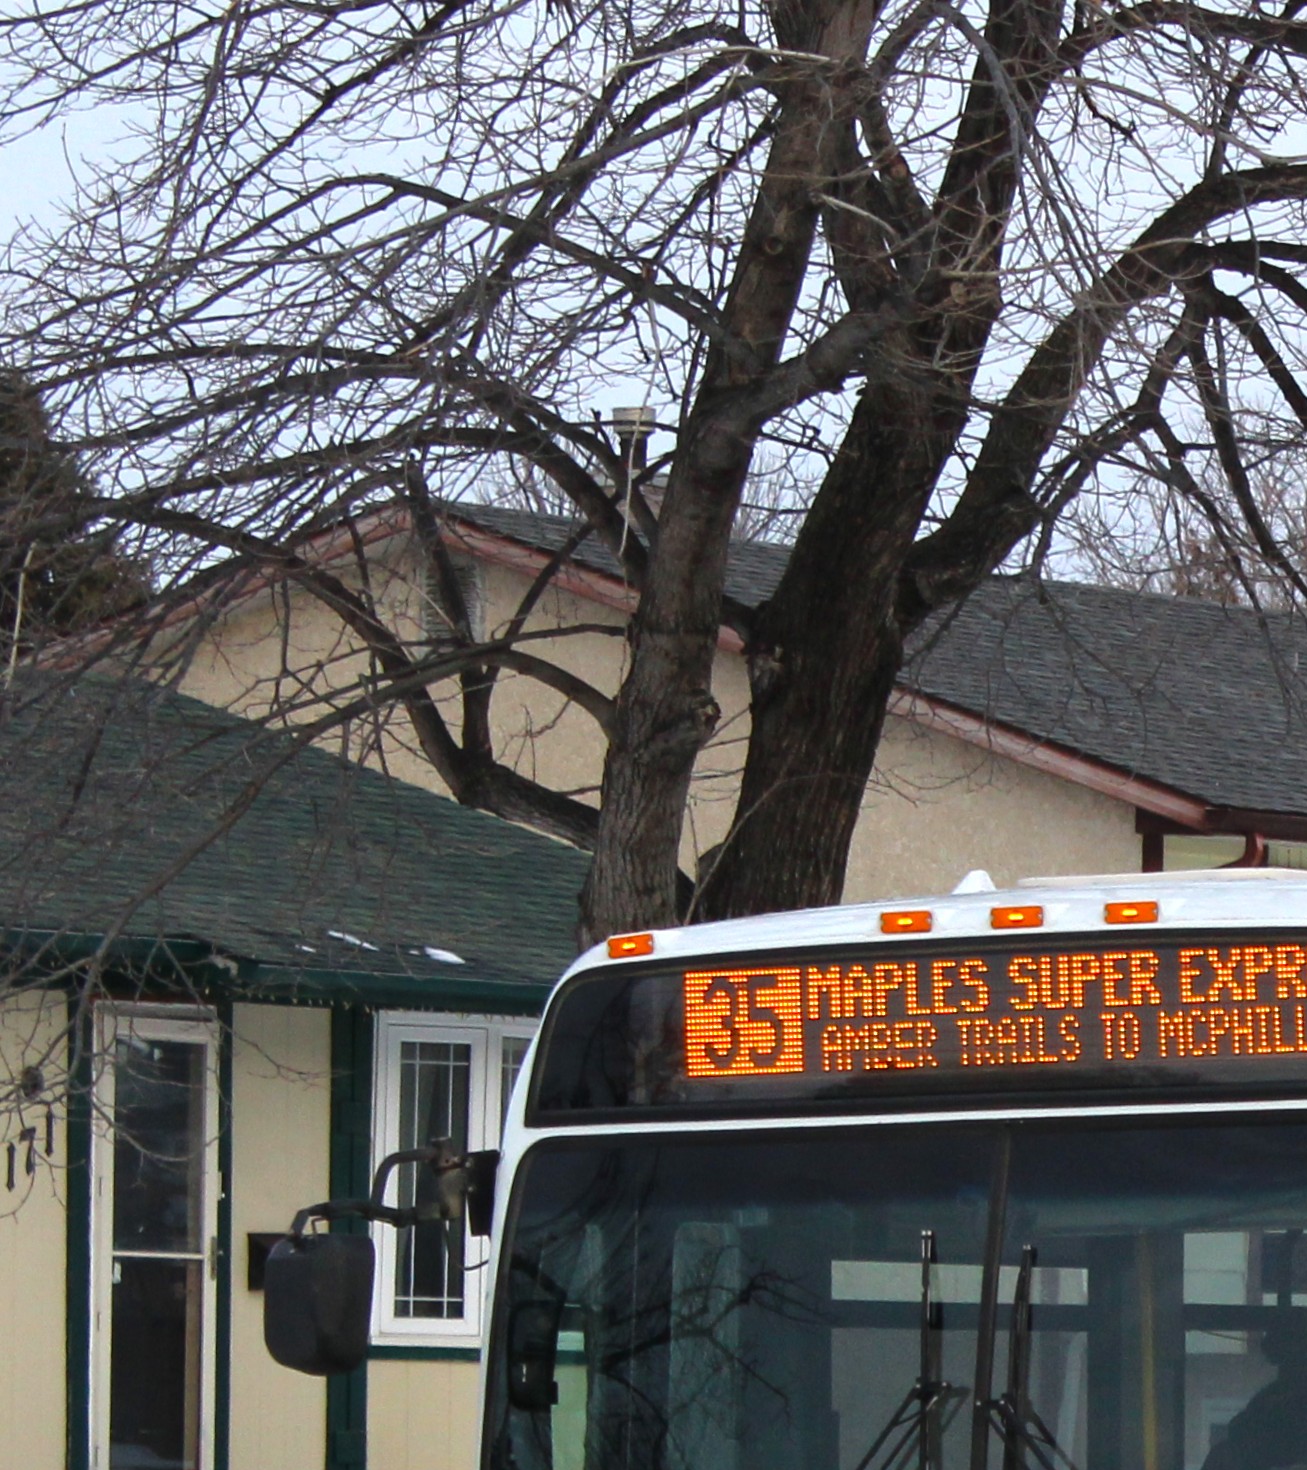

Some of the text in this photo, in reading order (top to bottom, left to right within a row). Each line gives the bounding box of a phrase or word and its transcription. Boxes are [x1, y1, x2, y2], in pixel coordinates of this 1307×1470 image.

[807, 959, 989, 1020] MAPLES
[1008, 951, 1162, 1011] SUPER
[697, 973, 792, 1071] 35
[821, 1021, 938, 1073] AMBER
[957, 1014, 1081, 1066] TRAILS
[1100, 1010, 1141, 1060] TO
